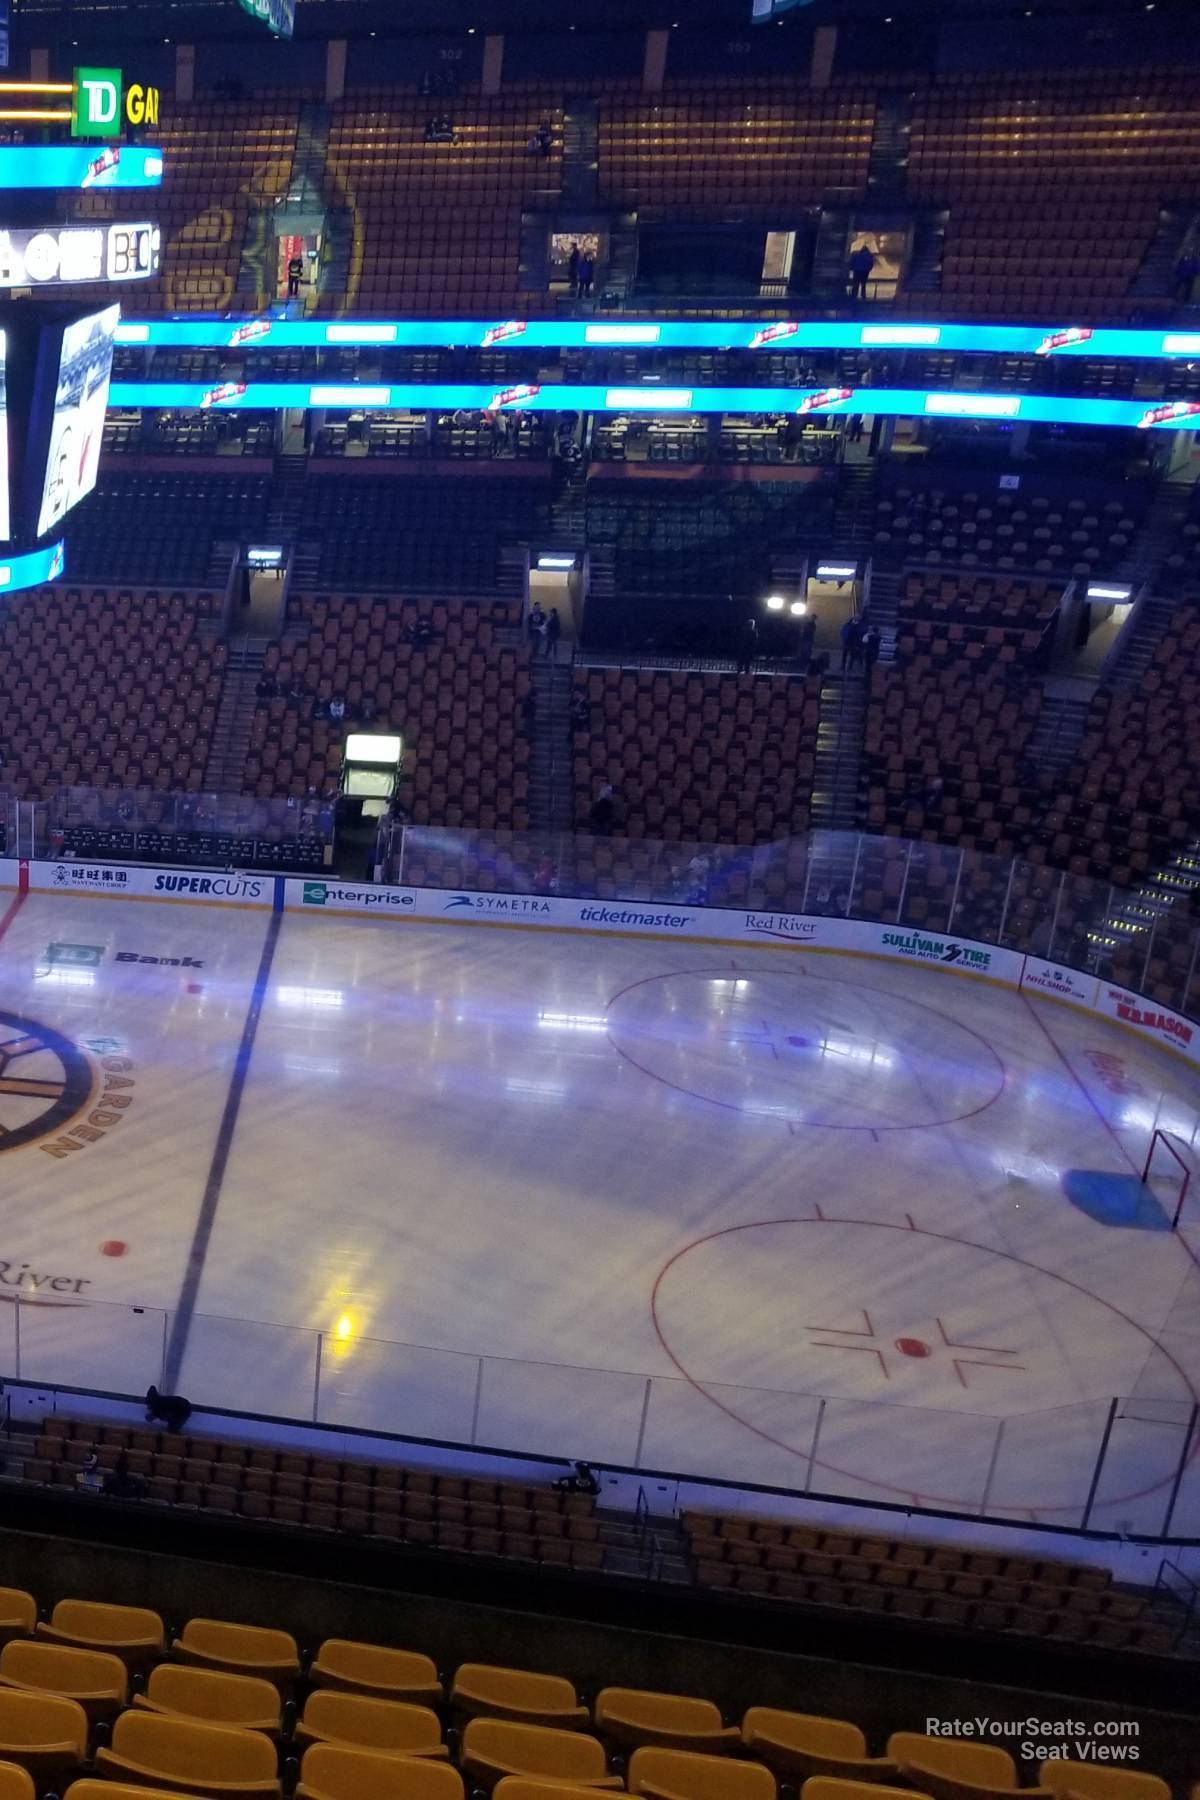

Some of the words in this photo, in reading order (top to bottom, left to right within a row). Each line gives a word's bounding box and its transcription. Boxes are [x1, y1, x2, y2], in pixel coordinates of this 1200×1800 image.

[82, 80, 117, 123] TD
[154, 874, 262, 897] SUPERCUTS
[305, 886, 414, 905] enterprise
[476, 896, 551, 913] SYMETRA
[579, 906, 690, 928] ticketmaster
[744, 914, 774, 930] Red
[777, 916, 818, 933] River
[881, 932, 945, 954] SULLIVAN
[962, 948, 992, 965] TIRE
[114, 951, 205, 969] Bank
[39, 1055, 135, 1160] GARDEN
